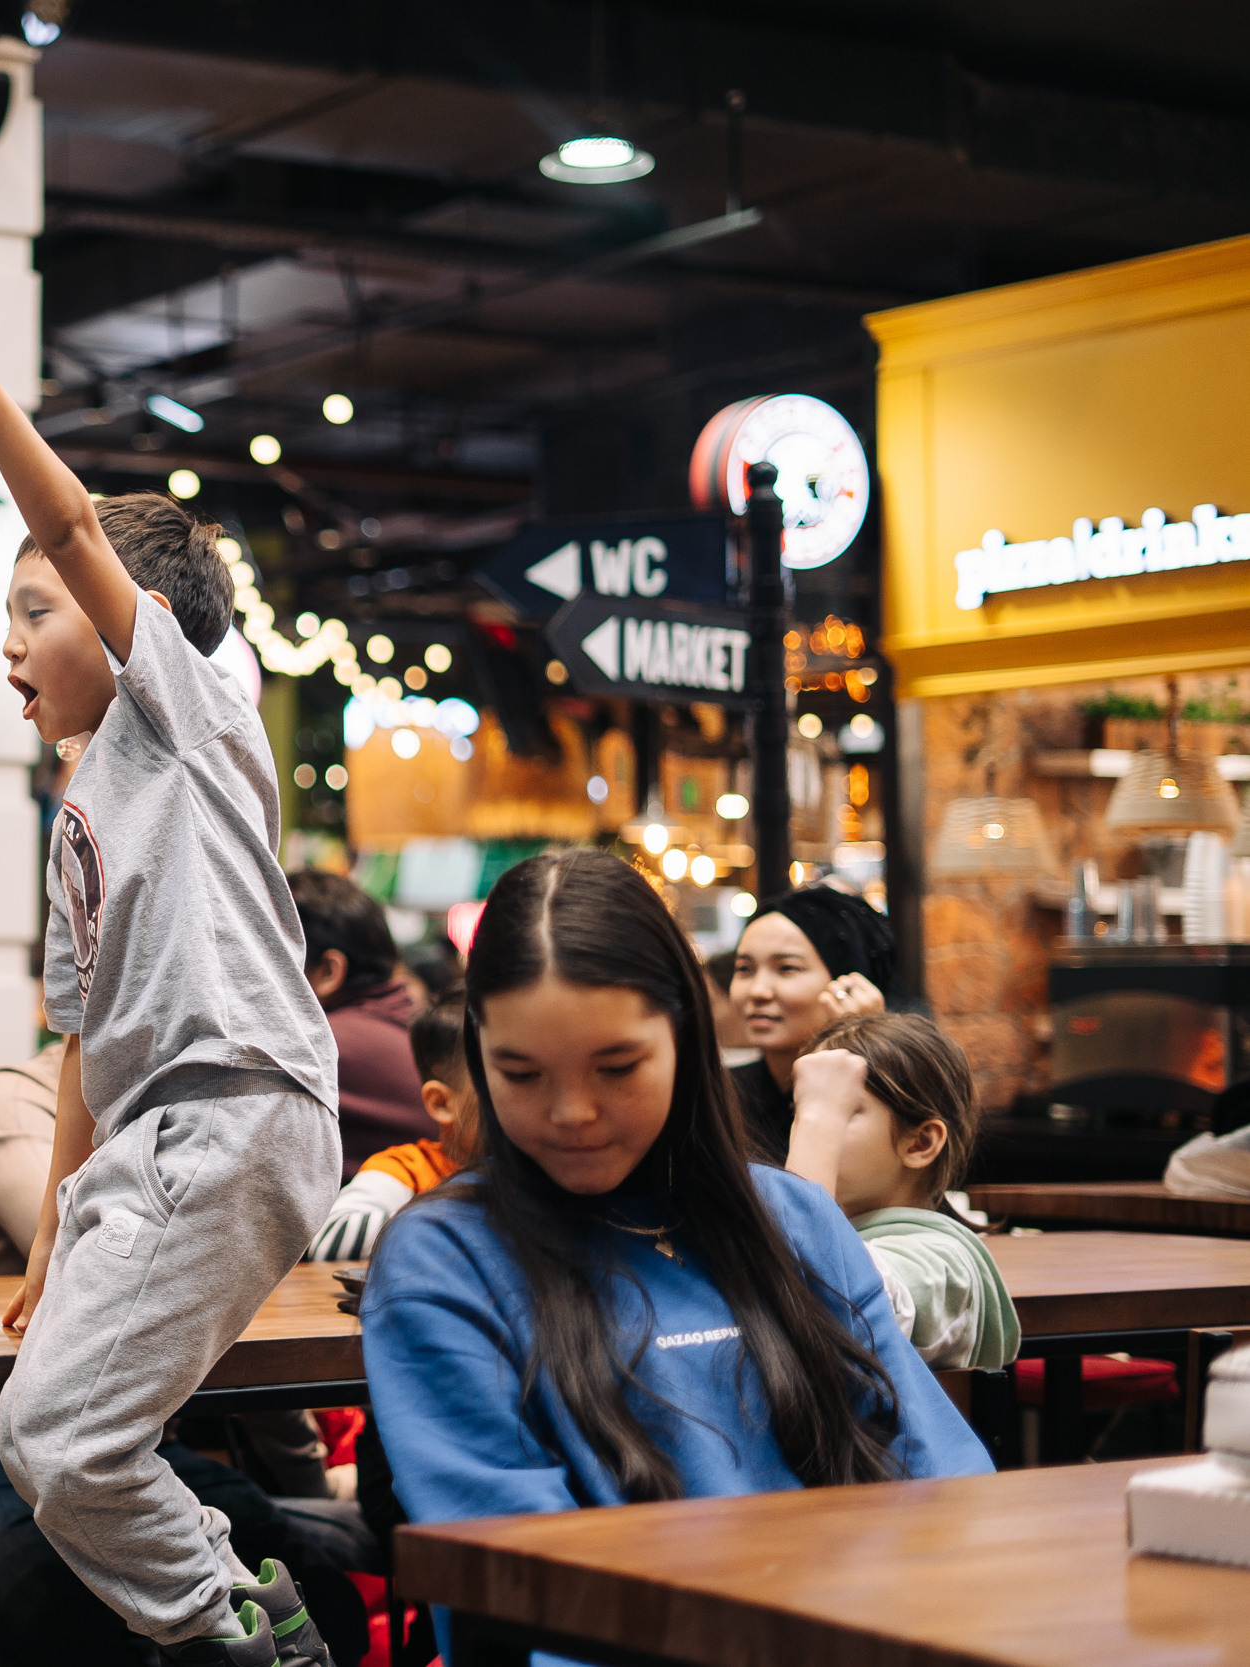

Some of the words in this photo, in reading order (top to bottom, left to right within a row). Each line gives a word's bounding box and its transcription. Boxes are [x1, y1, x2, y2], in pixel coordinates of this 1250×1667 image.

[590, 537, 667, 597] WC
[623, 617, 750, 692] MARKET
[656, 1332, 703, 1349] QAZAQ
[703, 1326, 742, 1342] REPU
